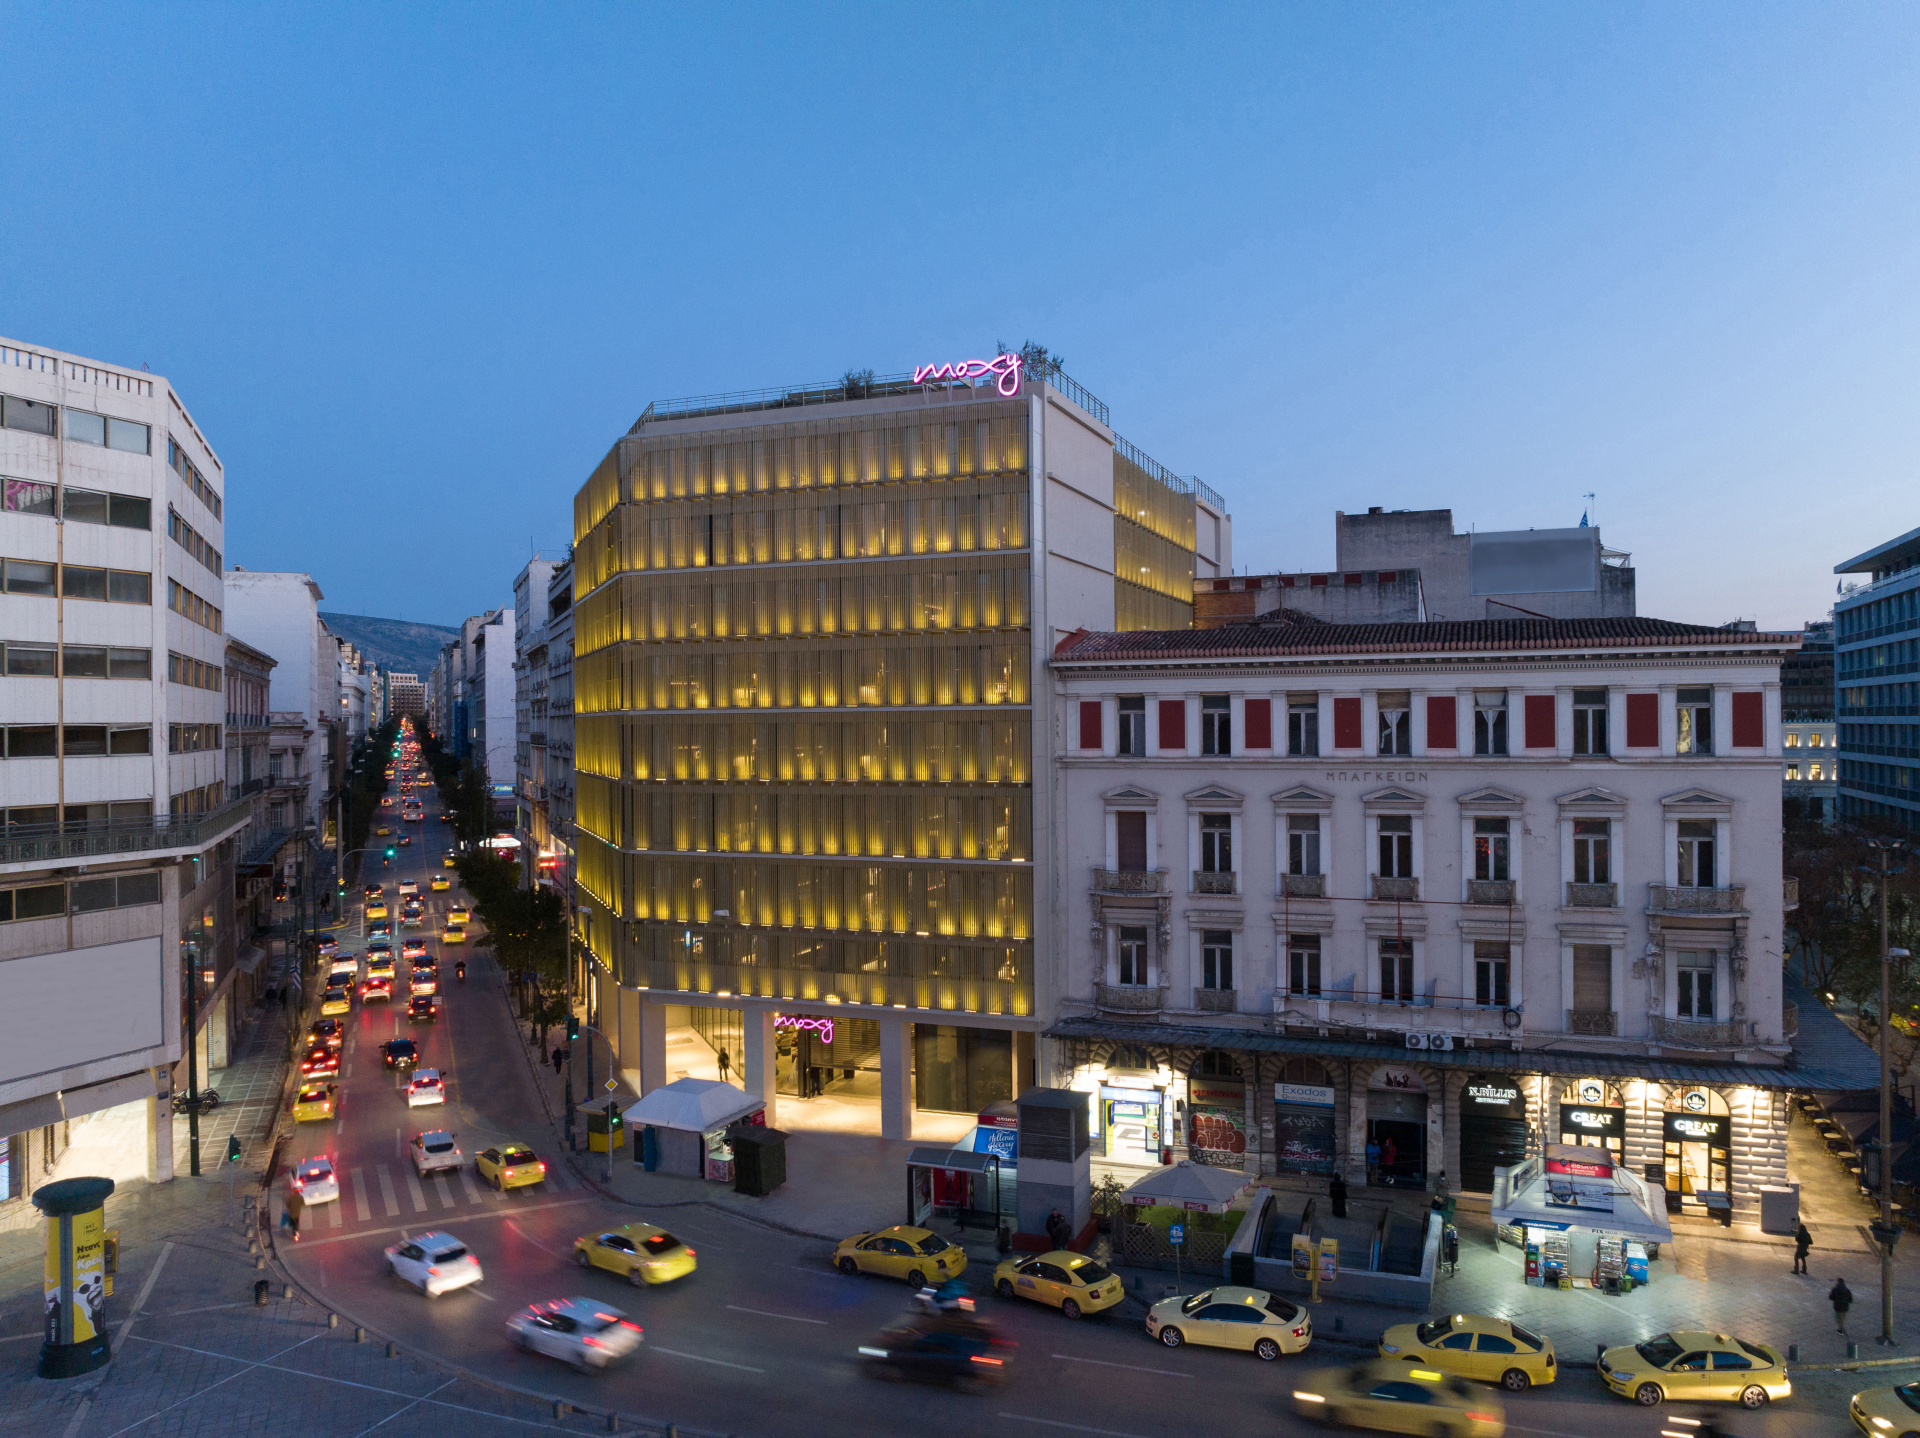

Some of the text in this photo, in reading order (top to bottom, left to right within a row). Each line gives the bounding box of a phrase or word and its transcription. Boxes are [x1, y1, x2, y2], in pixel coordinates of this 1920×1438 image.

[913, 353, 1022, 397] moxy
[1326, 771, 1428, 782] ΜΠΑΓΚΕΙΟΝ
[773, 1016, 834, 1044] moxy
[1282, 1084, 1327, 1098] Exodos
[1570, 1111, 1613, 1125] GREAT
[1674, 1119, 1718, 1133] GREAT
